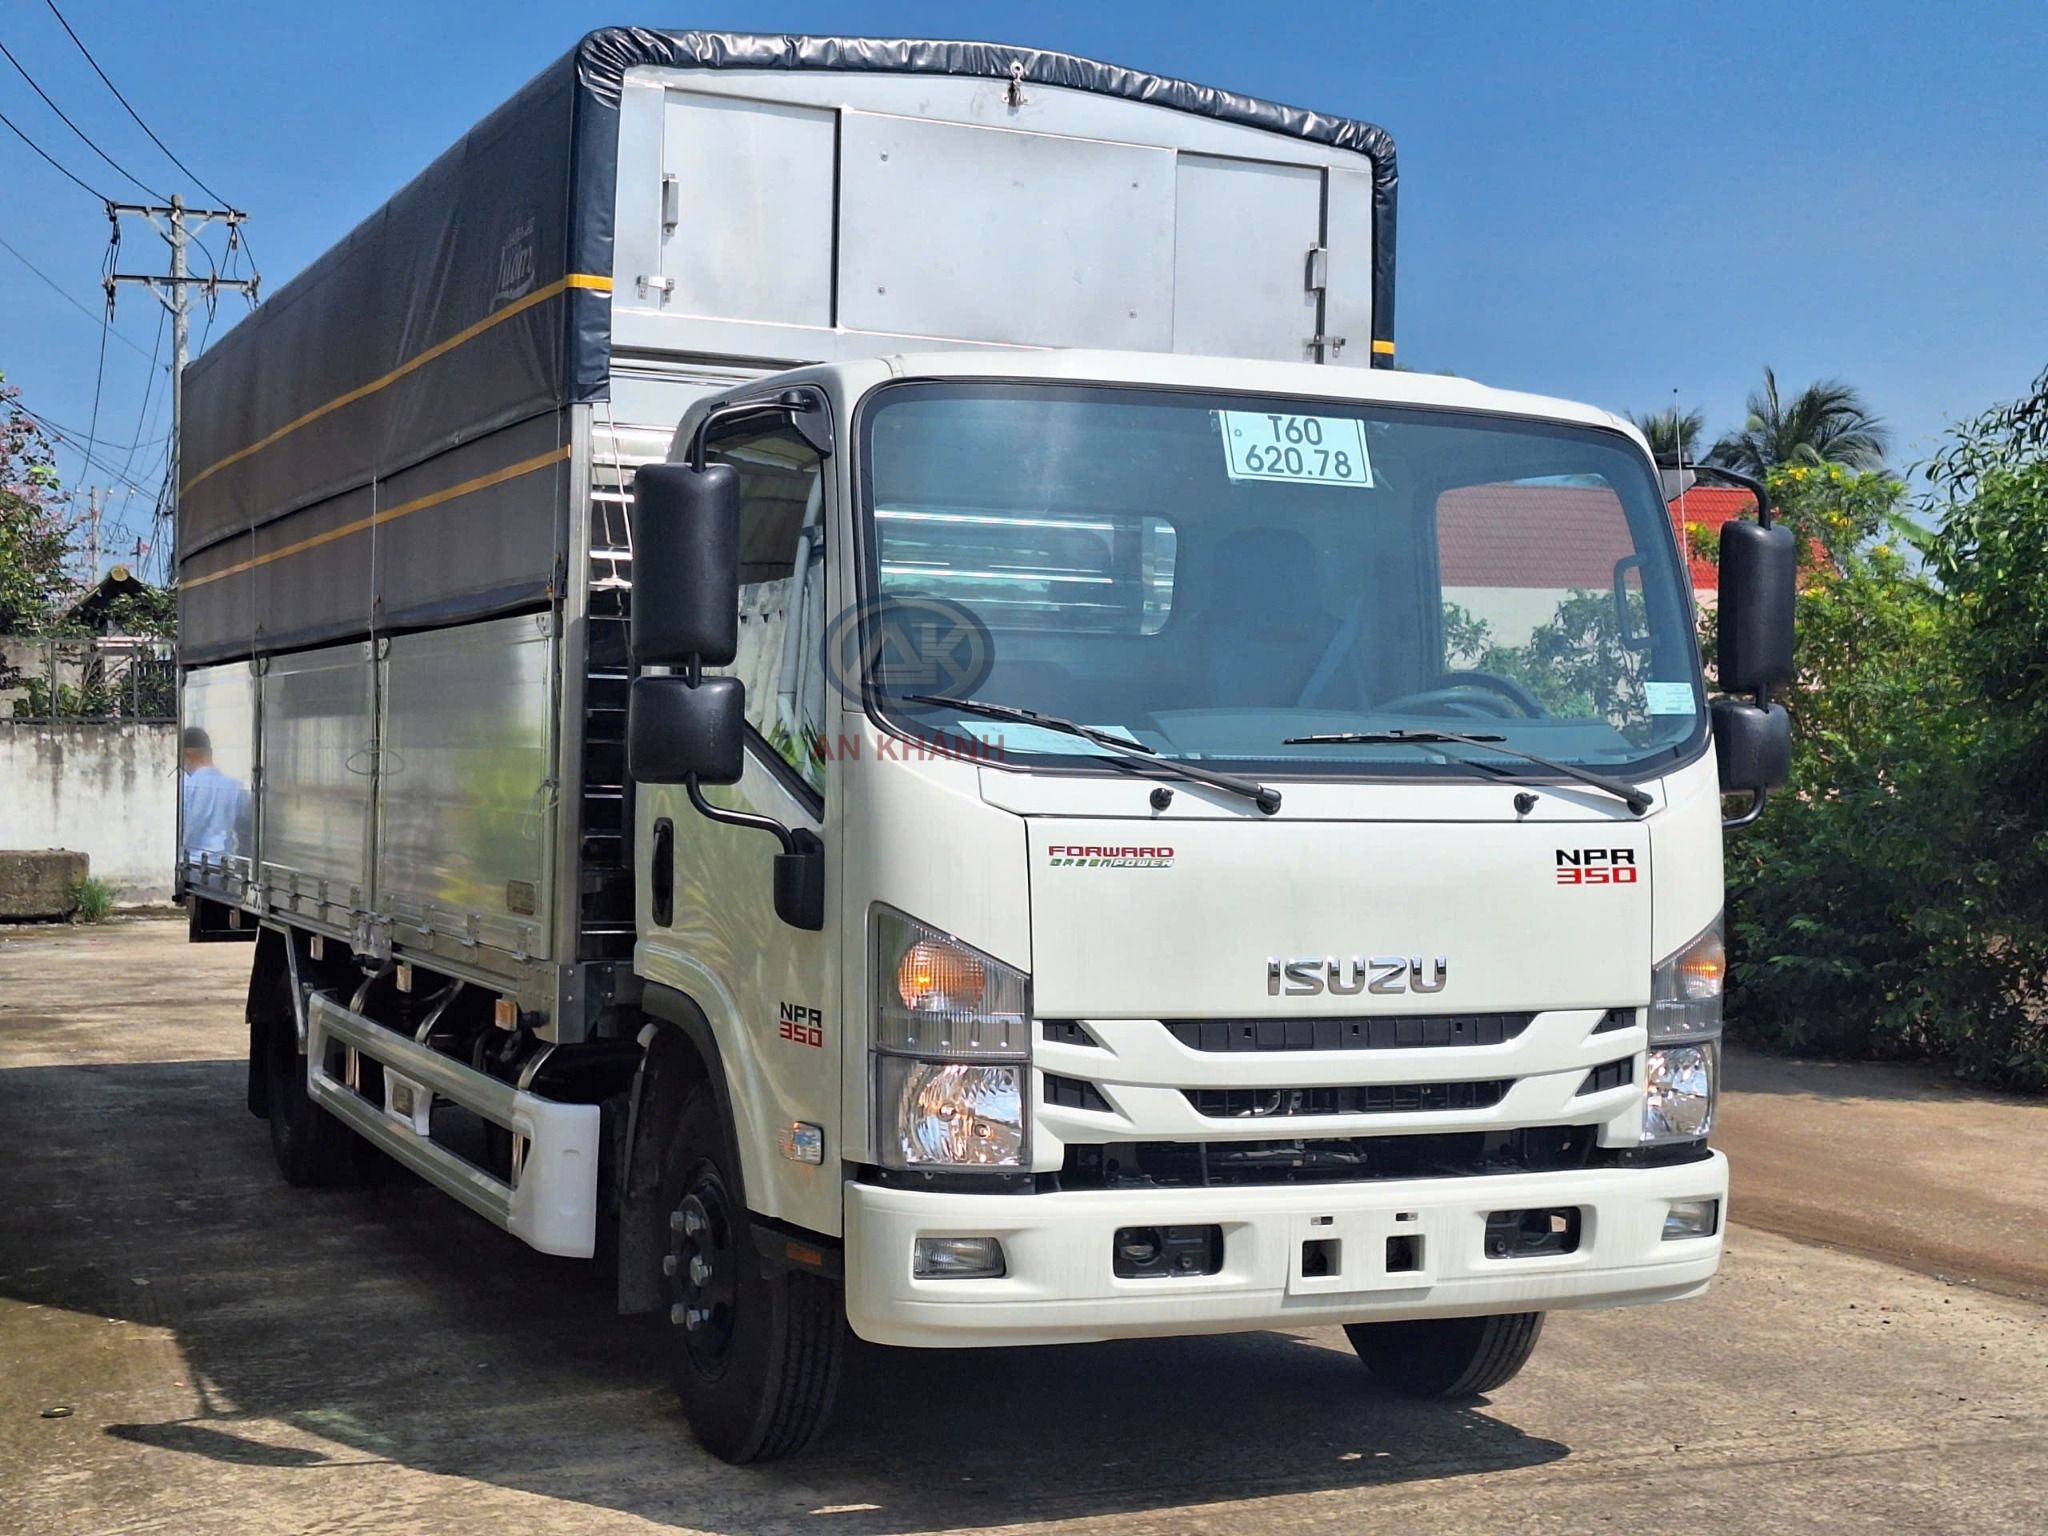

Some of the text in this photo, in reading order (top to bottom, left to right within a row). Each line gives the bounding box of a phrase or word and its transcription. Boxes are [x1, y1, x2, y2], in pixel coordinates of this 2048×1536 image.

[1268, 415, 1323, 446] T60
[1246, 445, 1352, 479] 620.78
[1048, 845, 1175, 858] FORWARD
[1556, 848, 1636, 866] NPR
[1556, 867, 1637, 885] 350
[1267, 955, 1447, 997] ISUZU
[780, 1001, 822, 1028] NPR
[779, 1020, 823, 1049] 350
